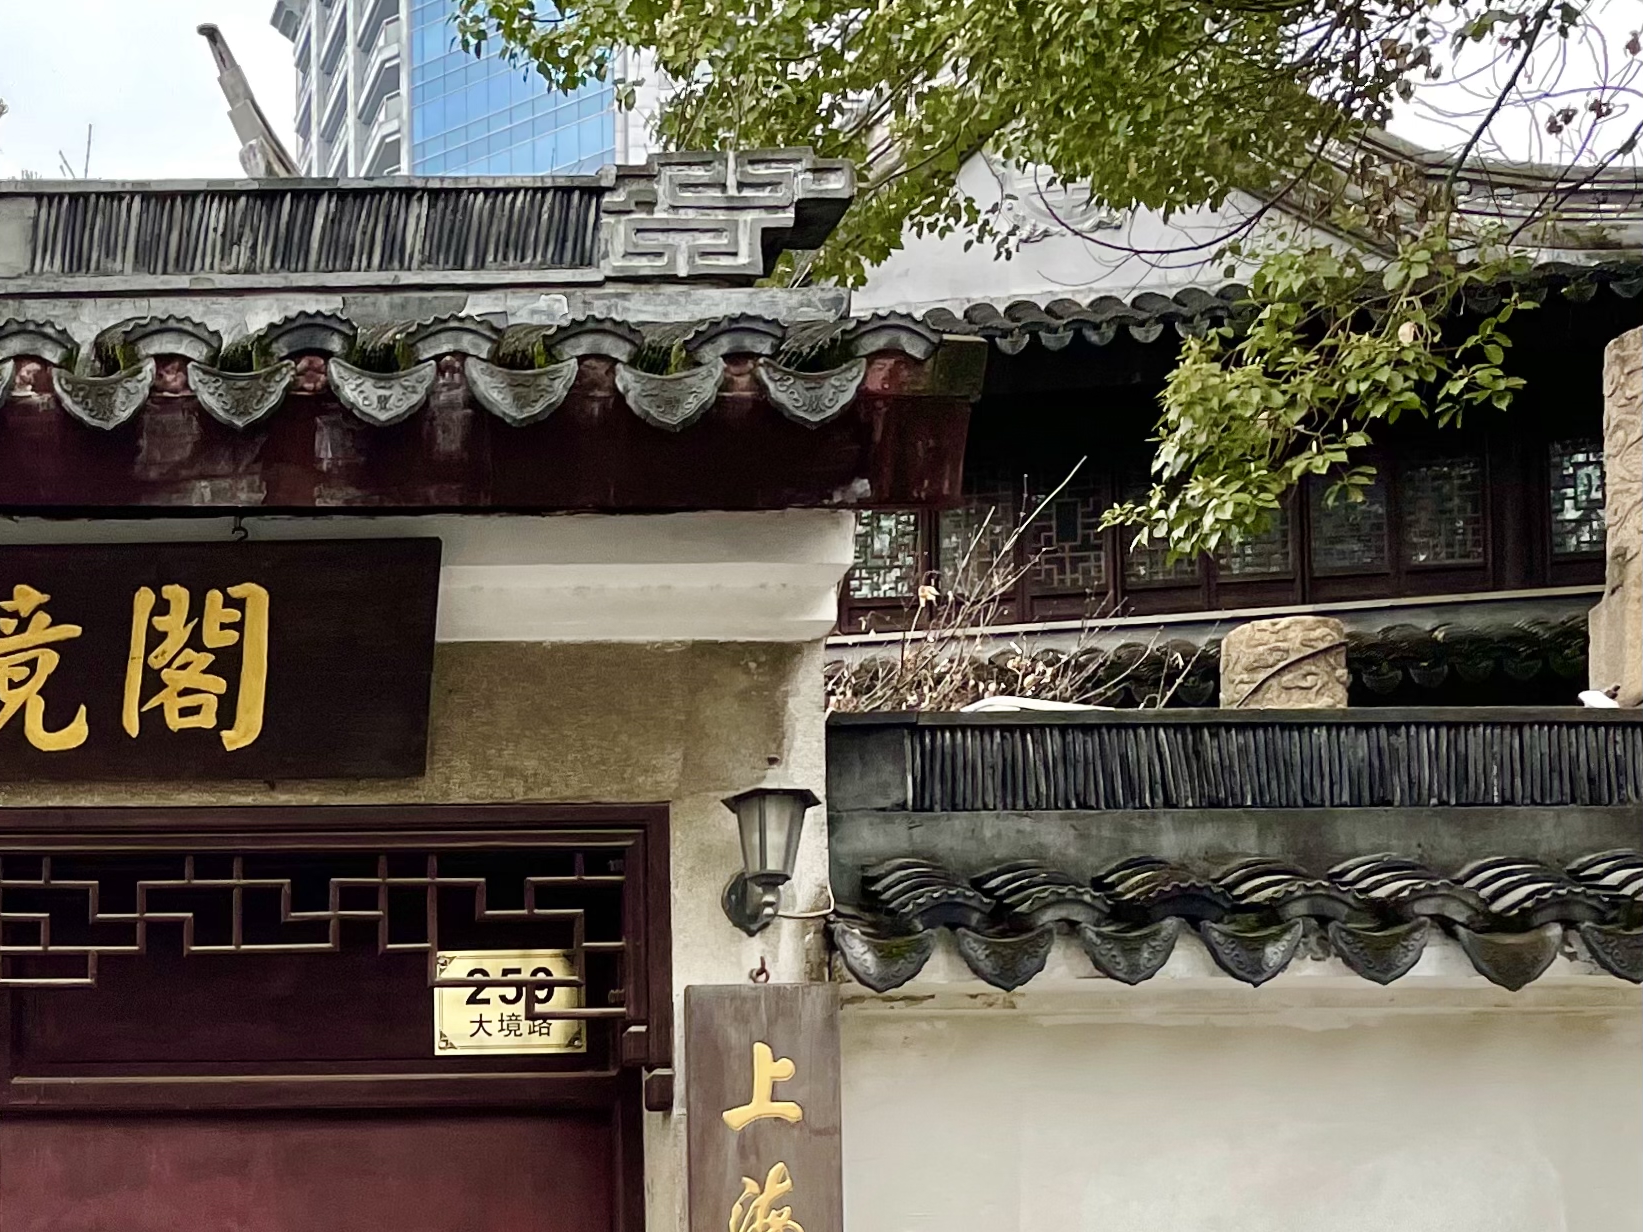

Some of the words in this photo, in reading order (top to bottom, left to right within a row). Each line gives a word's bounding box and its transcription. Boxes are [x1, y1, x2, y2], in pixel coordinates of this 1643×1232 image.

[466, 966, 555, 1005] 259
[469, 1012, 553, 1038] 大境路
